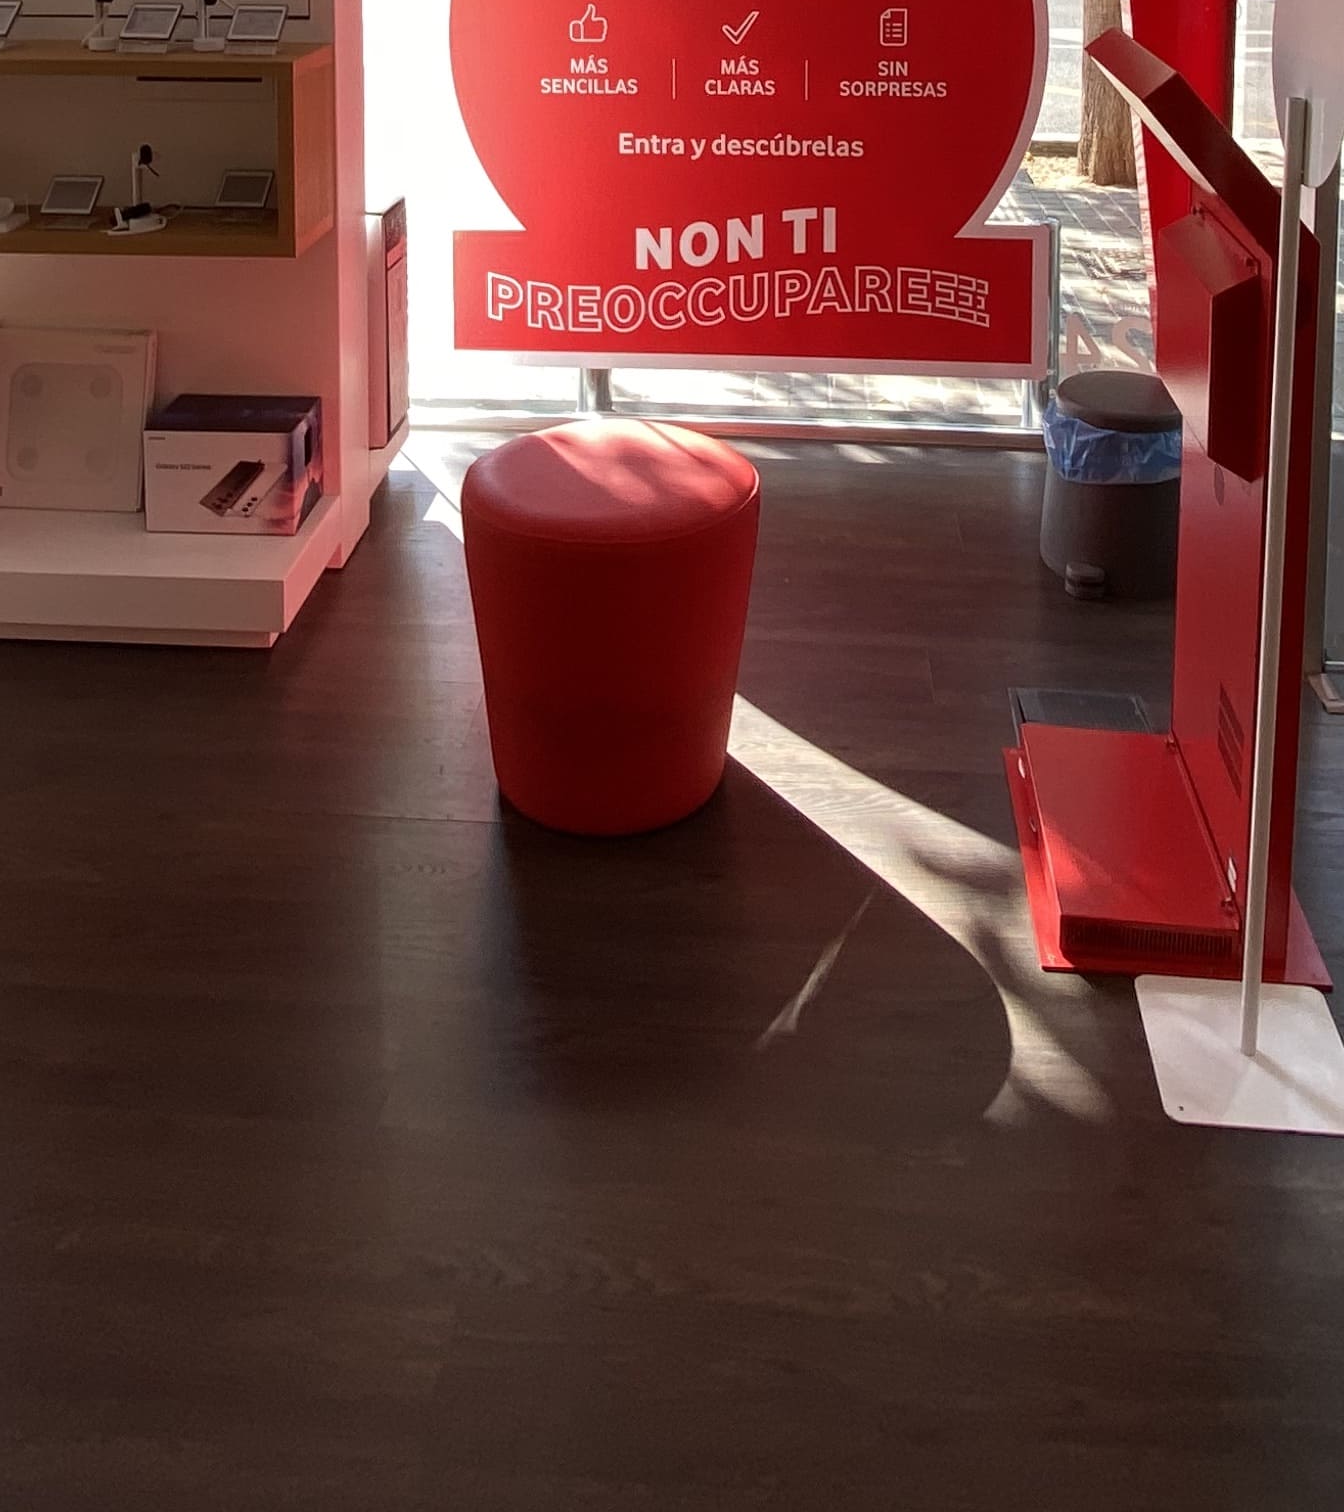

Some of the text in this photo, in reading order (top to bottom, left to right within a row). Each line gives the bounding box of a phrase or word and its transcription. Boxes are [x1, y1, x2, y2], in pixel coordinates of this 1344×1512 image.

[570, 55, 608, 74] MÁS
[720, 56, 759, 76] MÁS
[878, 61, 908, 77] SIN
[540, 78, 638, 95] SENCILLAS
[704, 79, 775, 96] CLARAS
[839, 81, 947, 98] SORPRESAS
[618, 133, 864, 161] Entra y descúbrelas
[635, 207, 837, 271] NON TI
